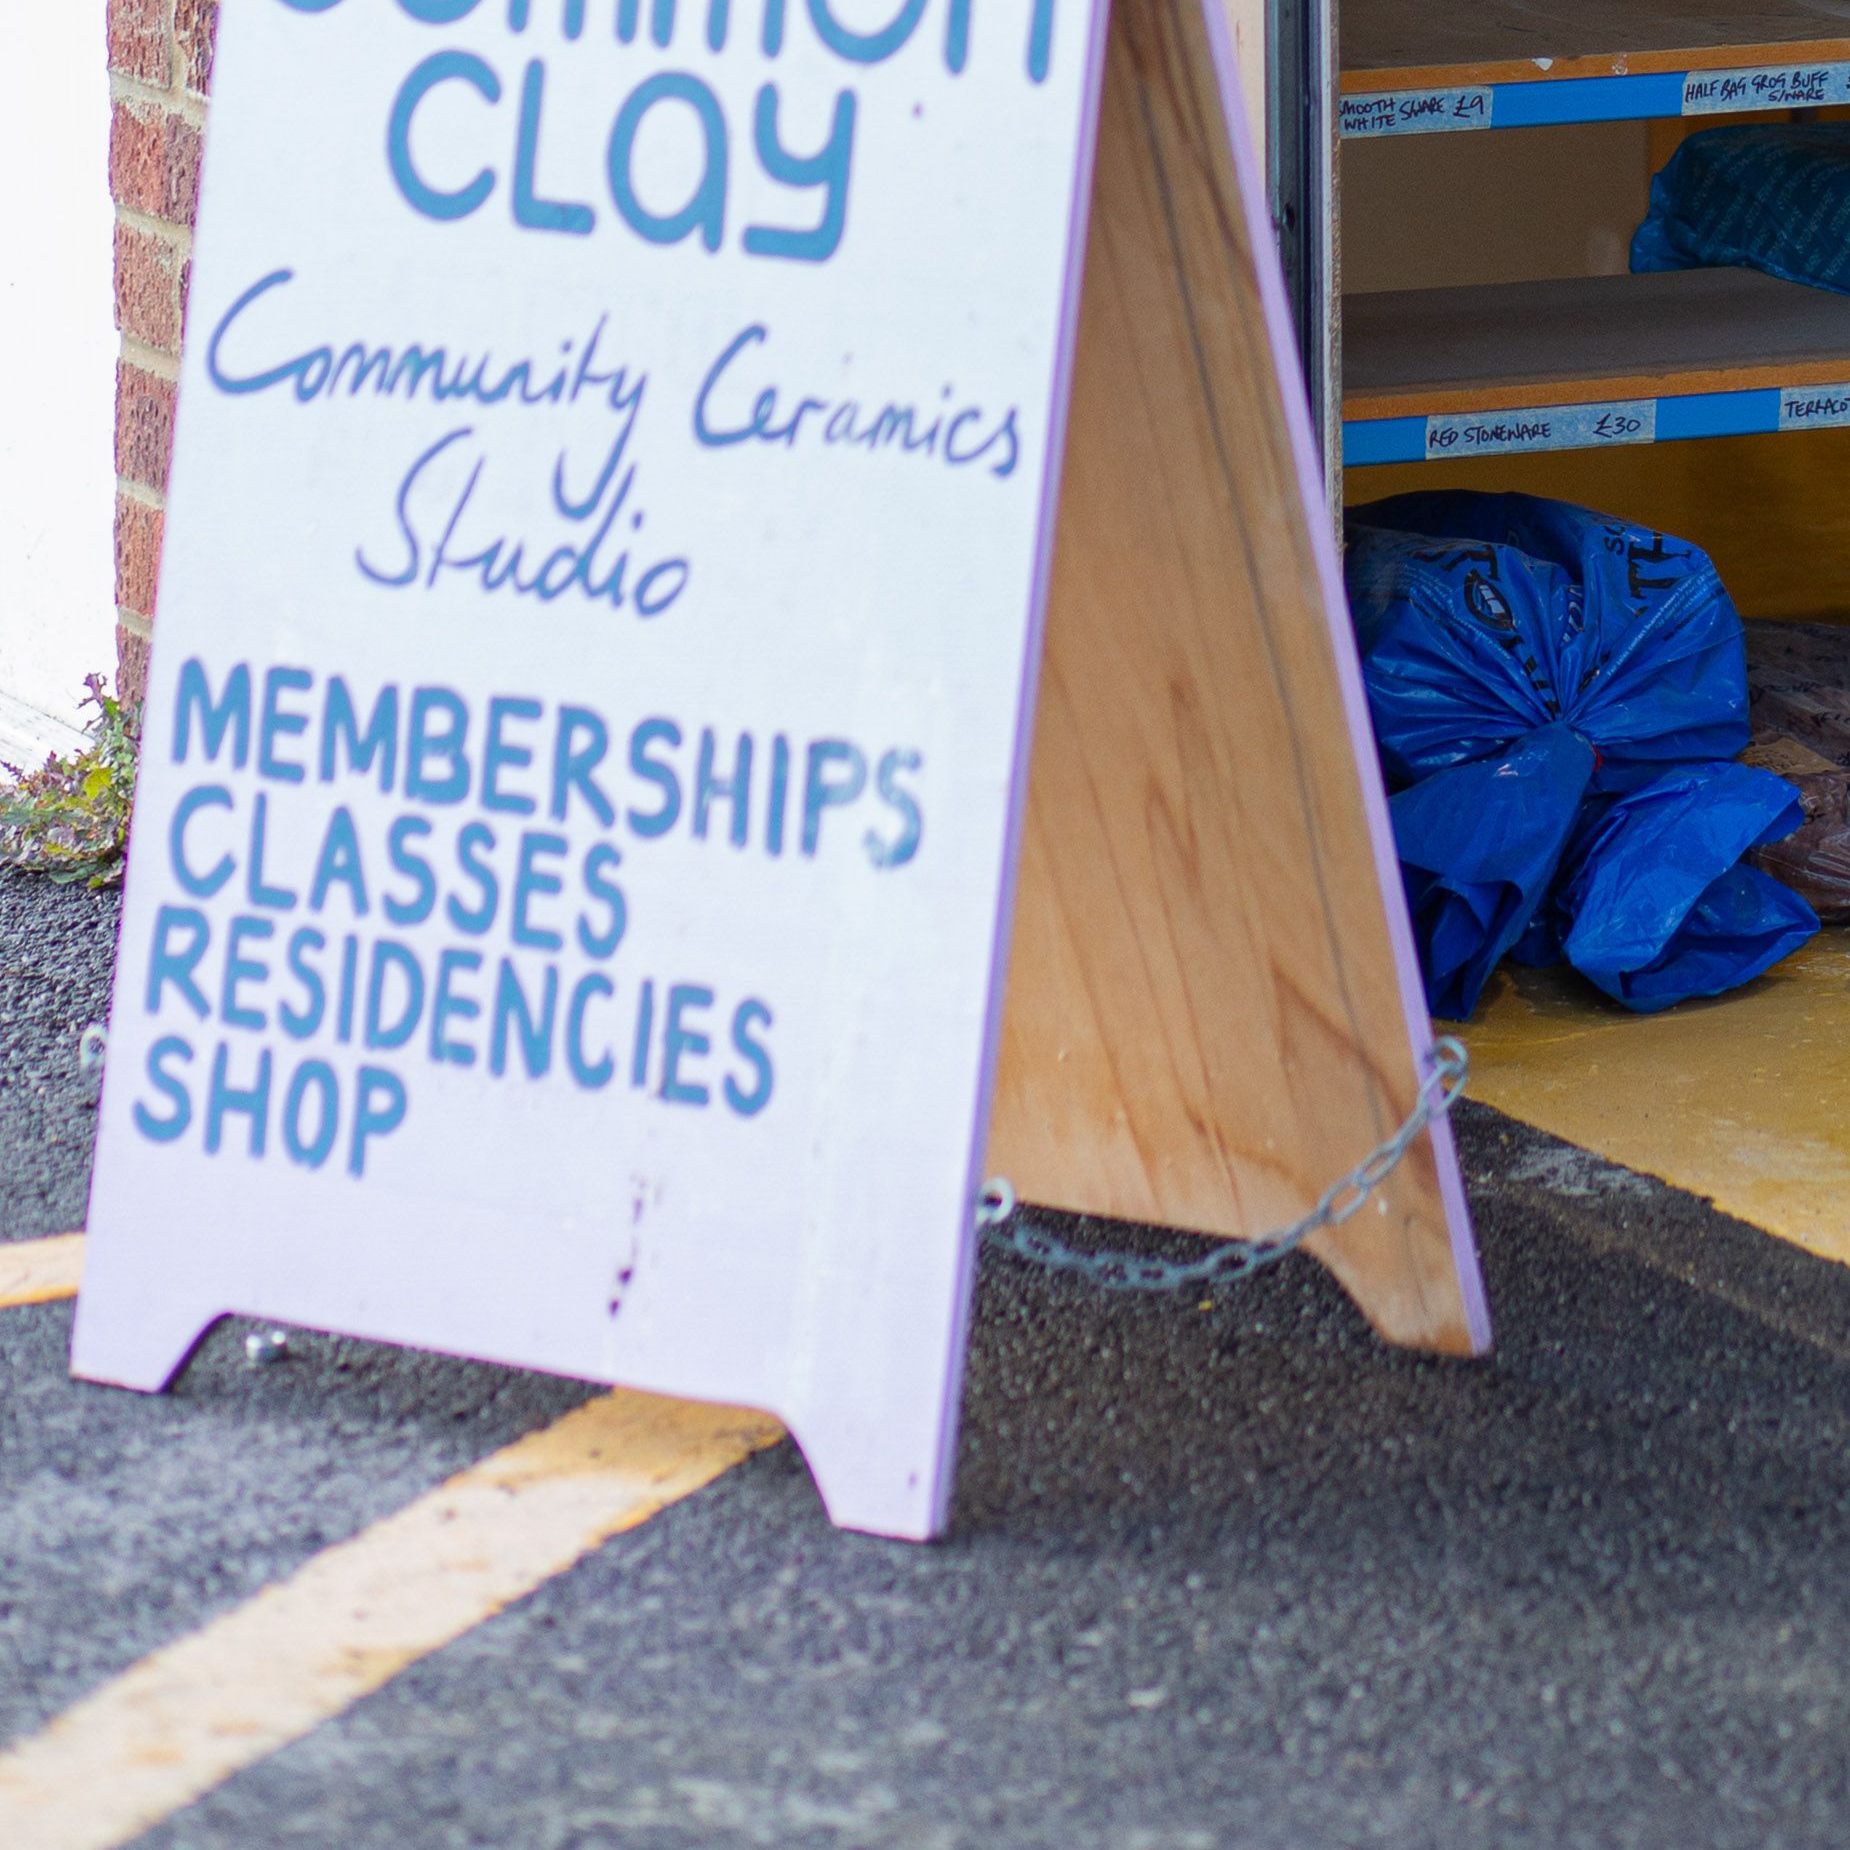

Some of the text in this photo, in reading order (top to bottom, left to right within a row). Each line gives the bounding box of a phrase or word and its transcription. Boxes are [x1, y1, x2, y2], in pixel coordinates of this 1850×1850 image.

[1344, 114, 1396, 131] WHITE
[1453, 94, 1484, 118] £9
[1685, 80, 1718, 103] HALF
[1720, 76, 1746, 101] BAG
[1752, 73, 1787, 95] GROG
[1793, 70, 1829, 89] BUFF
[205, 267, 1021, 520] Community Ceramics
[1429, 413, 1641, 449] RED STONEWARE £30
[355, 427, 690, 618] Studio
[171, 658, 923, 870] MEMBERSHIPS
[166, 785, 630, 961] CLASSES
[145, 905, 775, 1118] RESIDENCIES
[132, 1035, 409, 1179] SHOP
